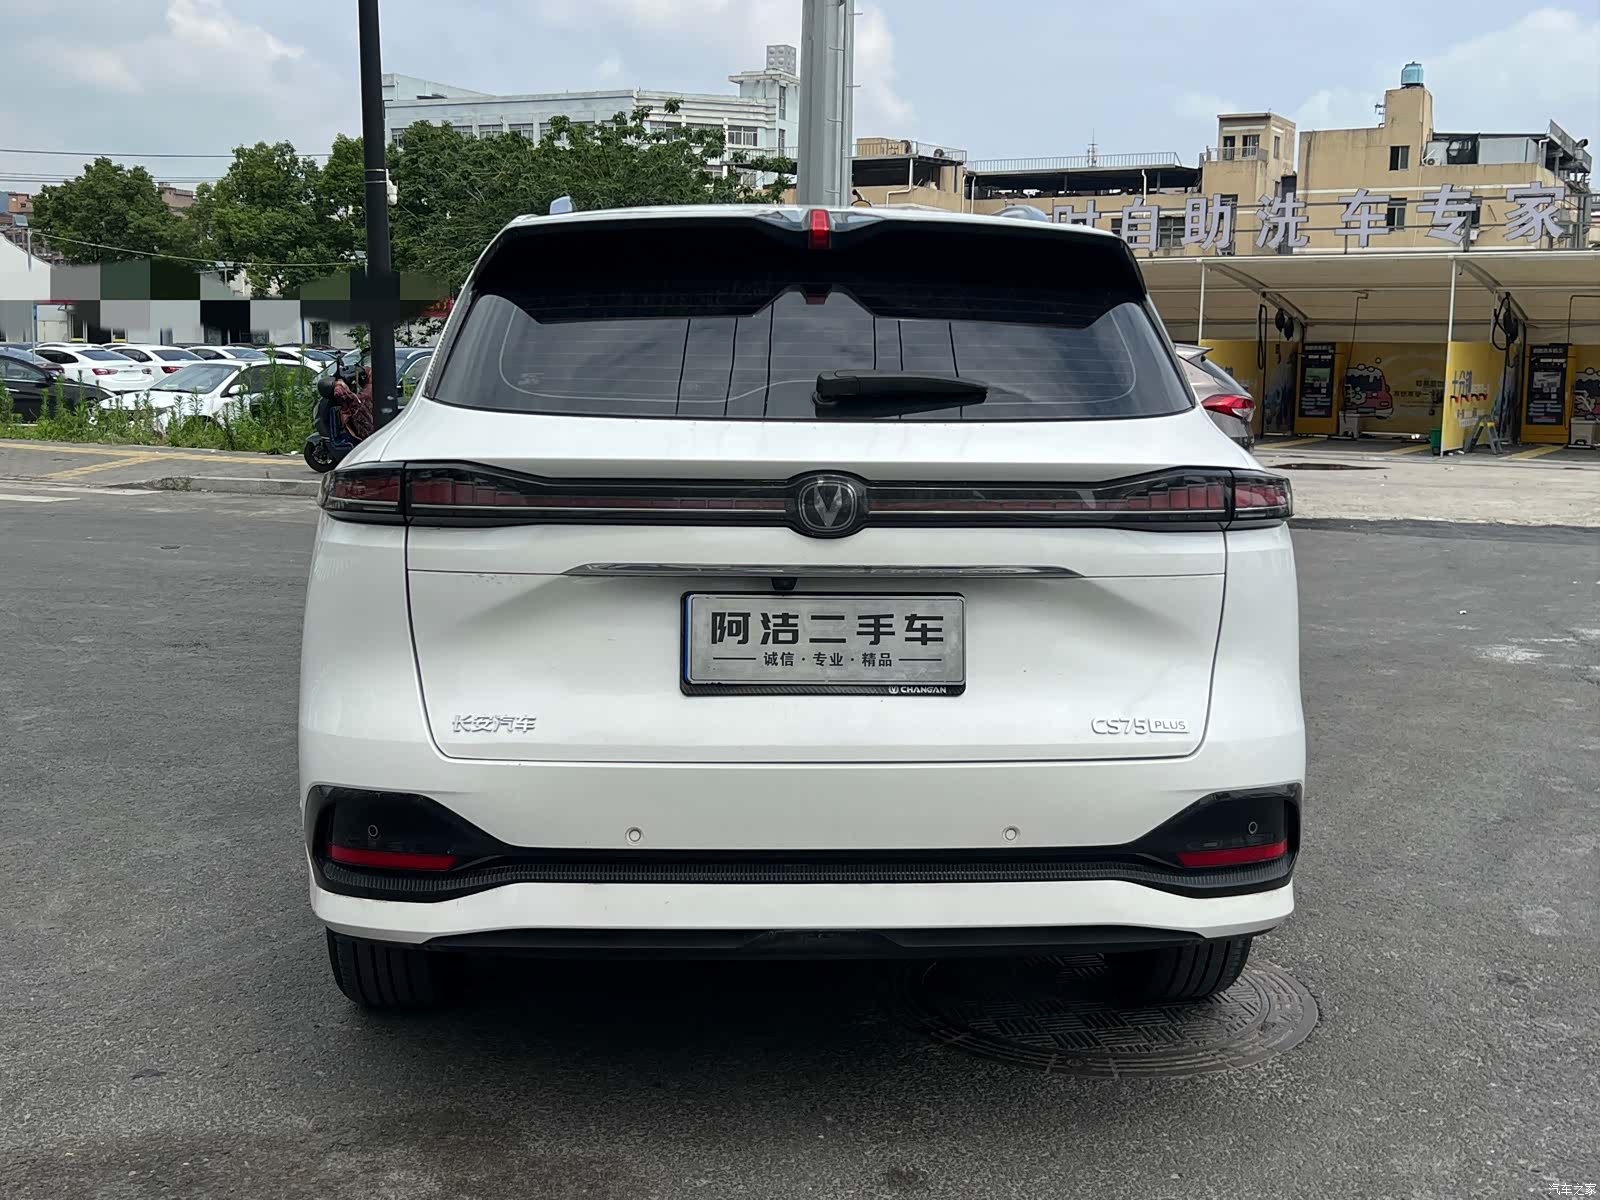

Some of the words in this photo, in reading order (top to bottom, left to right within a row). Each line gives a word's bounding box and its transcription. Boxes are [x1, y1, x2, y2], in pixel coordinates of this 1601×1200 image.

[711, 611, 944, 646] 阿洁二手车
[900, 686, 947, 694] CHANGAN
[451, 715, 537, 733] 长安汽车
[1091, 718, 1148, 735] CS75
[1154, 720, 1186, 730] PLUS
